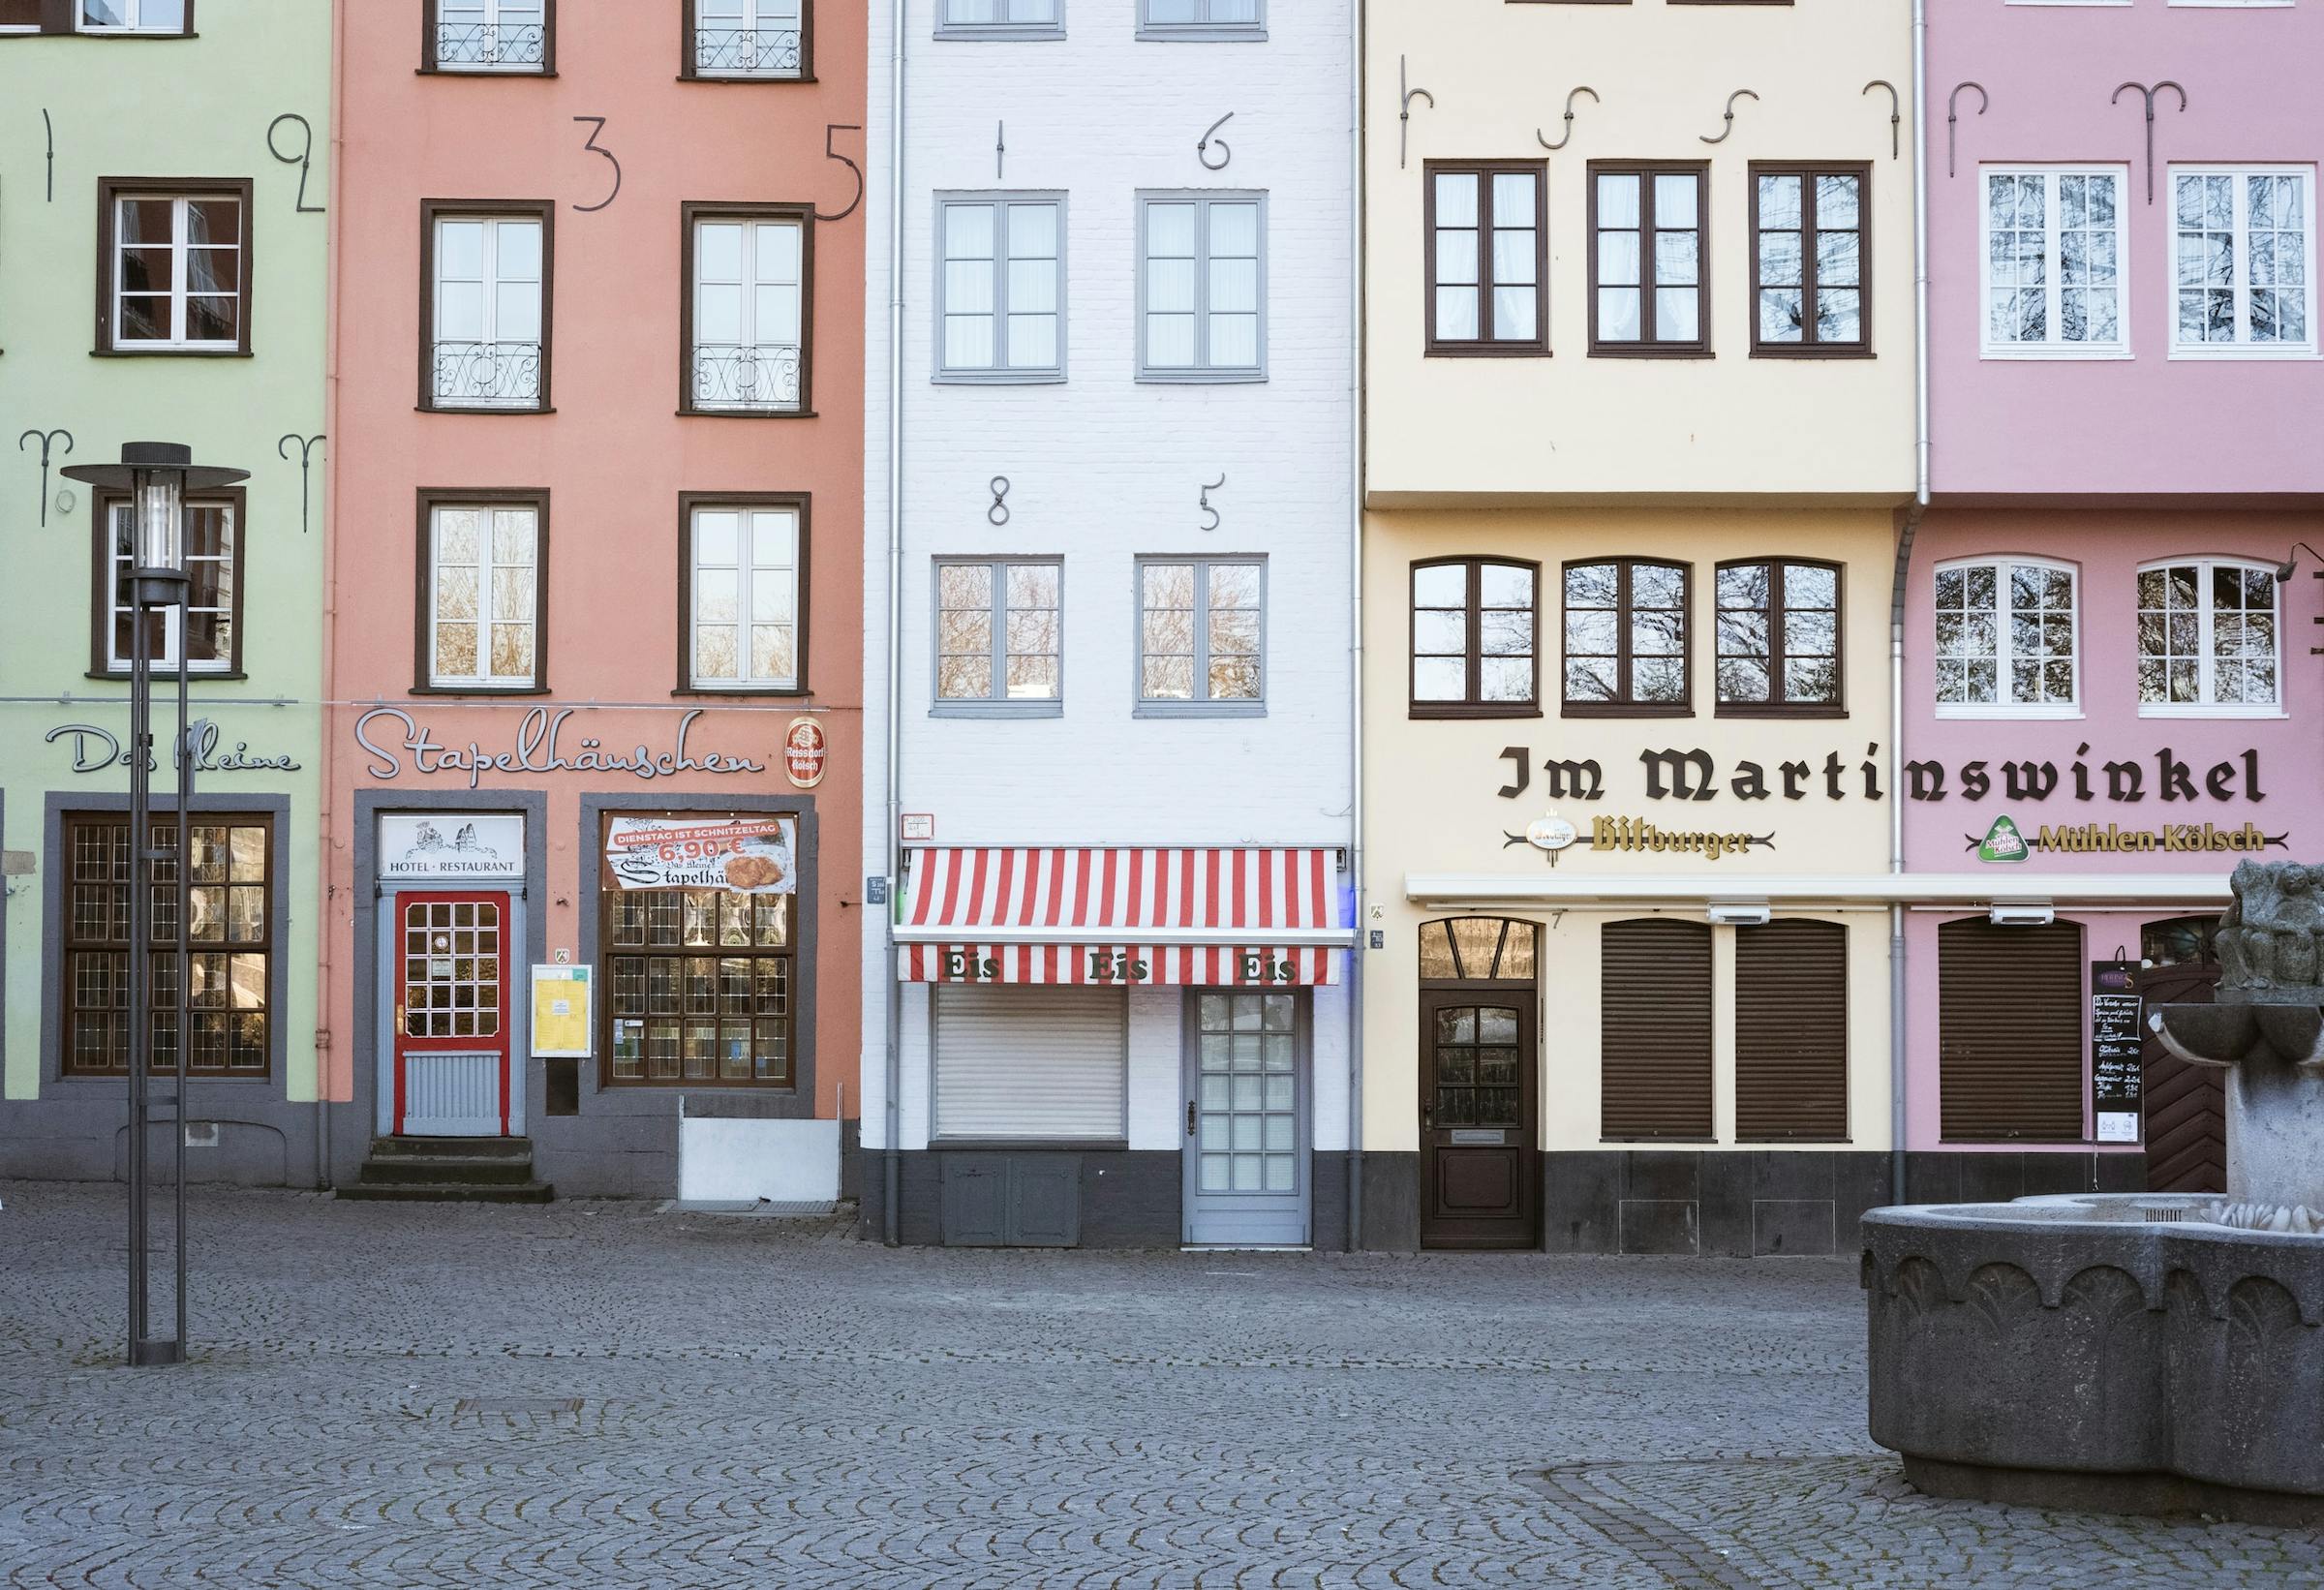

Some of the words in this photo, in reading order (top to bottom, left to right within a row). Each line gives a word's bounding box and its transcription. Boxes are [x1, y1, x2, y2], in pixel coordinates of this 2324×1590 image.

[354, 708, 765, 788] Stapelhäuschen
[1497, 746, 1605, 802] Im
[1639, 741, 2267, 803] Martinswinkel
[618, 832, 672, 843] DIENSTAG
[675, 830, 691, 840] IST
[695, 824, 776, 837] SCHNITZELTAG
[1590, 814, 1753, 860] Bitburger
[2037, 823, 2156, 852] Mühlen
[2163, 823, 2264, 852] Kölsch
[658, 841, 719, 863] 6,90
[728, 837, 746, 854] €
[390, 862, 429, 871] HOTEL
[440, 862, 514, 871] RESTAURANT
[941, 951, 1000, 980] Eis
[1089, 952, 1148, 981] Eis
[1238, 953, 1297, 982] Eis
